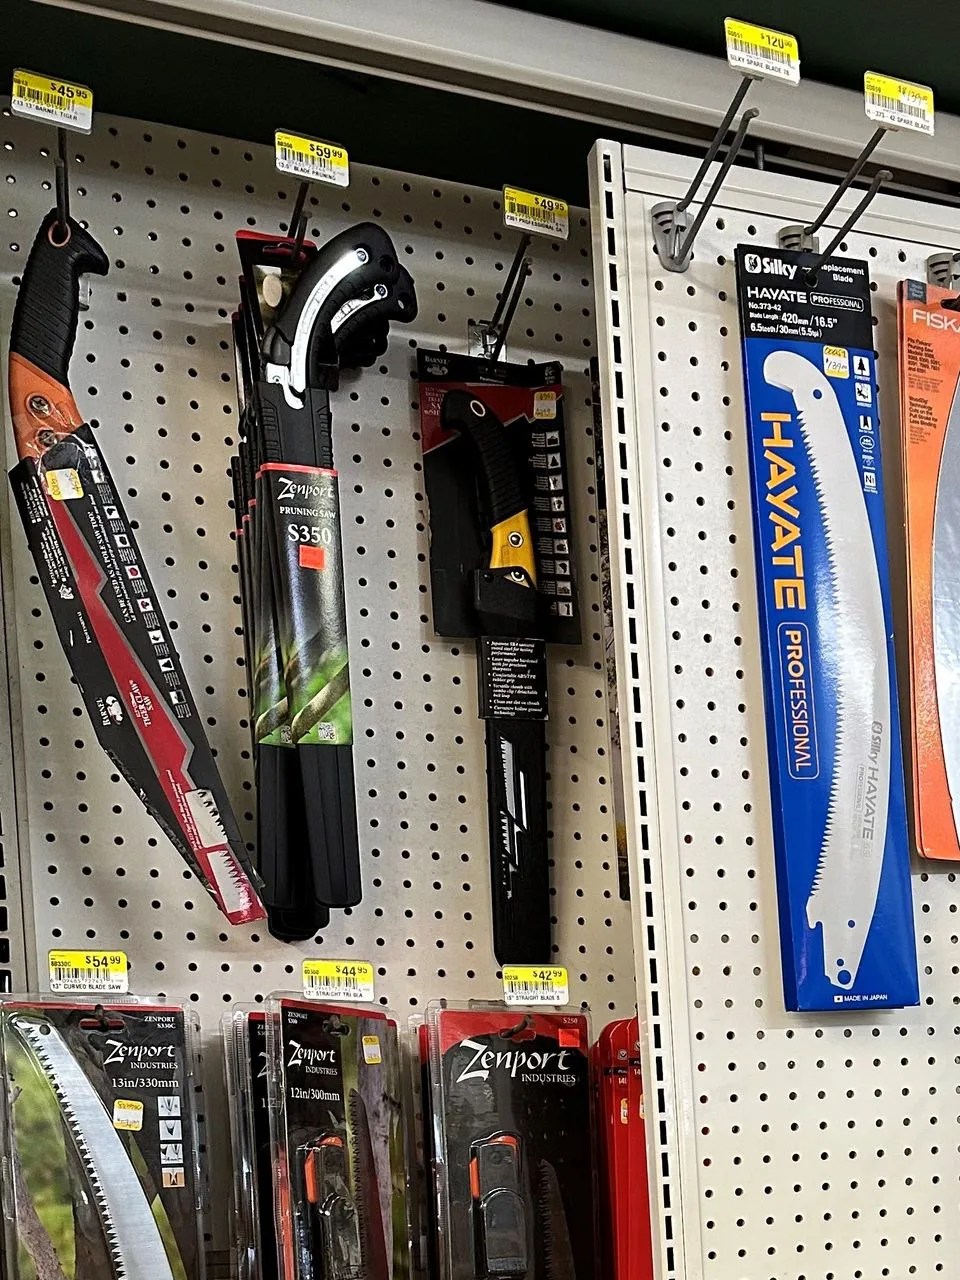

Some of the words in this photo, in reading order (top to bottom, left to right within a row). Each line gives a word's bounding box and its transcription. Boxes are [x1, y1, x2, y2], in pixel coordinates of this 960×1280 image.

[747, 59, 764, 68] SPARE
[765, 64, 781, 73] BLADE
[763, 257, 798, 280] Silky
[821, 262, 865, 276] eplacement
[832, 274, 854, 284] Blade
[747, 286, 808, 304] HAYATE
[813, 294, 862, 309] PROFESSIONAL
[277, 477, 335, 501] Zenport
[280, 506, 319, 518] PRUNING
[320, 511, 337, 519] SAW
[760, 411, 807, 610] HAYATE
[287, 523, 332, 545] S350
[785, 629, 812, 770] PROFESSIONAL
[862, 765, 880, 841] HAYATE
[869, 993, 888, 1001] JAPAN
[104, 1040, 176, 1065] Zenport
[287, 1040, 336, 1067] Zenport
[456, 1039, 571, 1084] Zenport
[131, 1061, 178, 1070] INDUSTRIES
[305, 1065, 338, 1076] INDUSTRIES
[112, 1078, 179, 1089] 13in/330mm
[521, 1074, 576, 1083] INDUSTRIES
[291, 1087, 341, 1101] 12in/300mm
